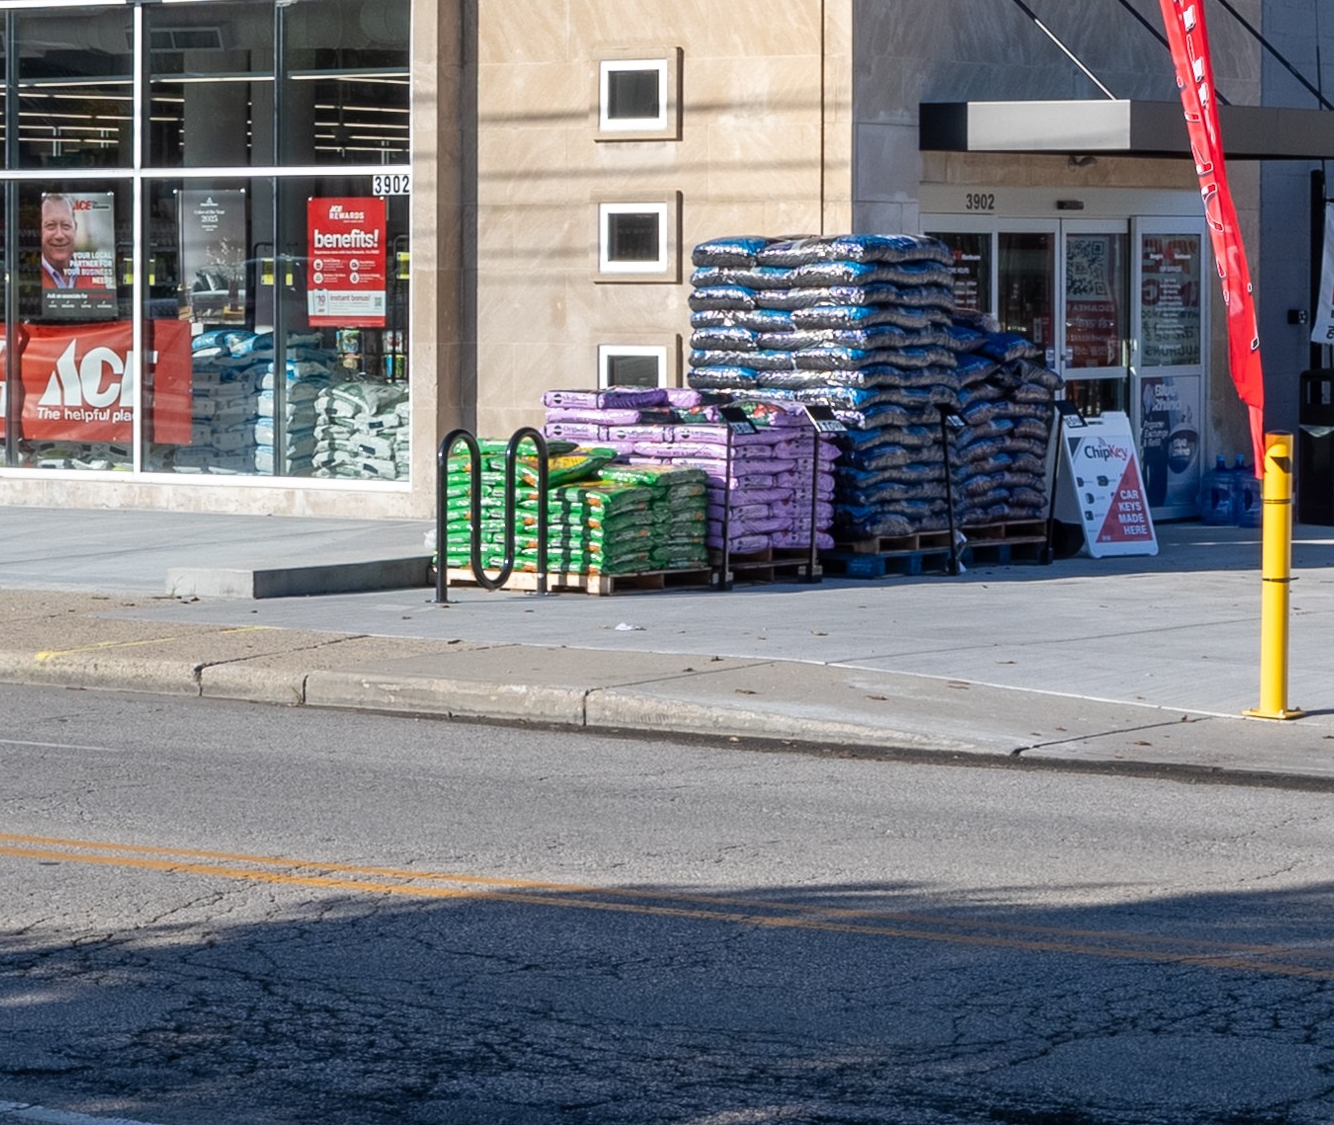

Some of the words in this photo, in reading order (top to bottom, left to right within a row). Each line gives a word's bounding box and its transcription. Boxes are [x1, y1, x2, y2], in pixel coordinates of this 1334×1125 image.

[375, 175, 410, 194] 3902
[966, 193, 995, 210] 3902
[314, 229, 379, 248] benefits!
[37, 408, 60, 421] The
[64, 407, 110, 423] helpful
[113, 408, 134, 423] pla
[1084, 445, 1127, 462] ChipKey
[1120, 490, 1138, 500] CAR
[1119, 502, 1142, 512] KEYS
[1119, 514, 1144, 523] MADE
[1124, 525, 1148, 535] HERE
